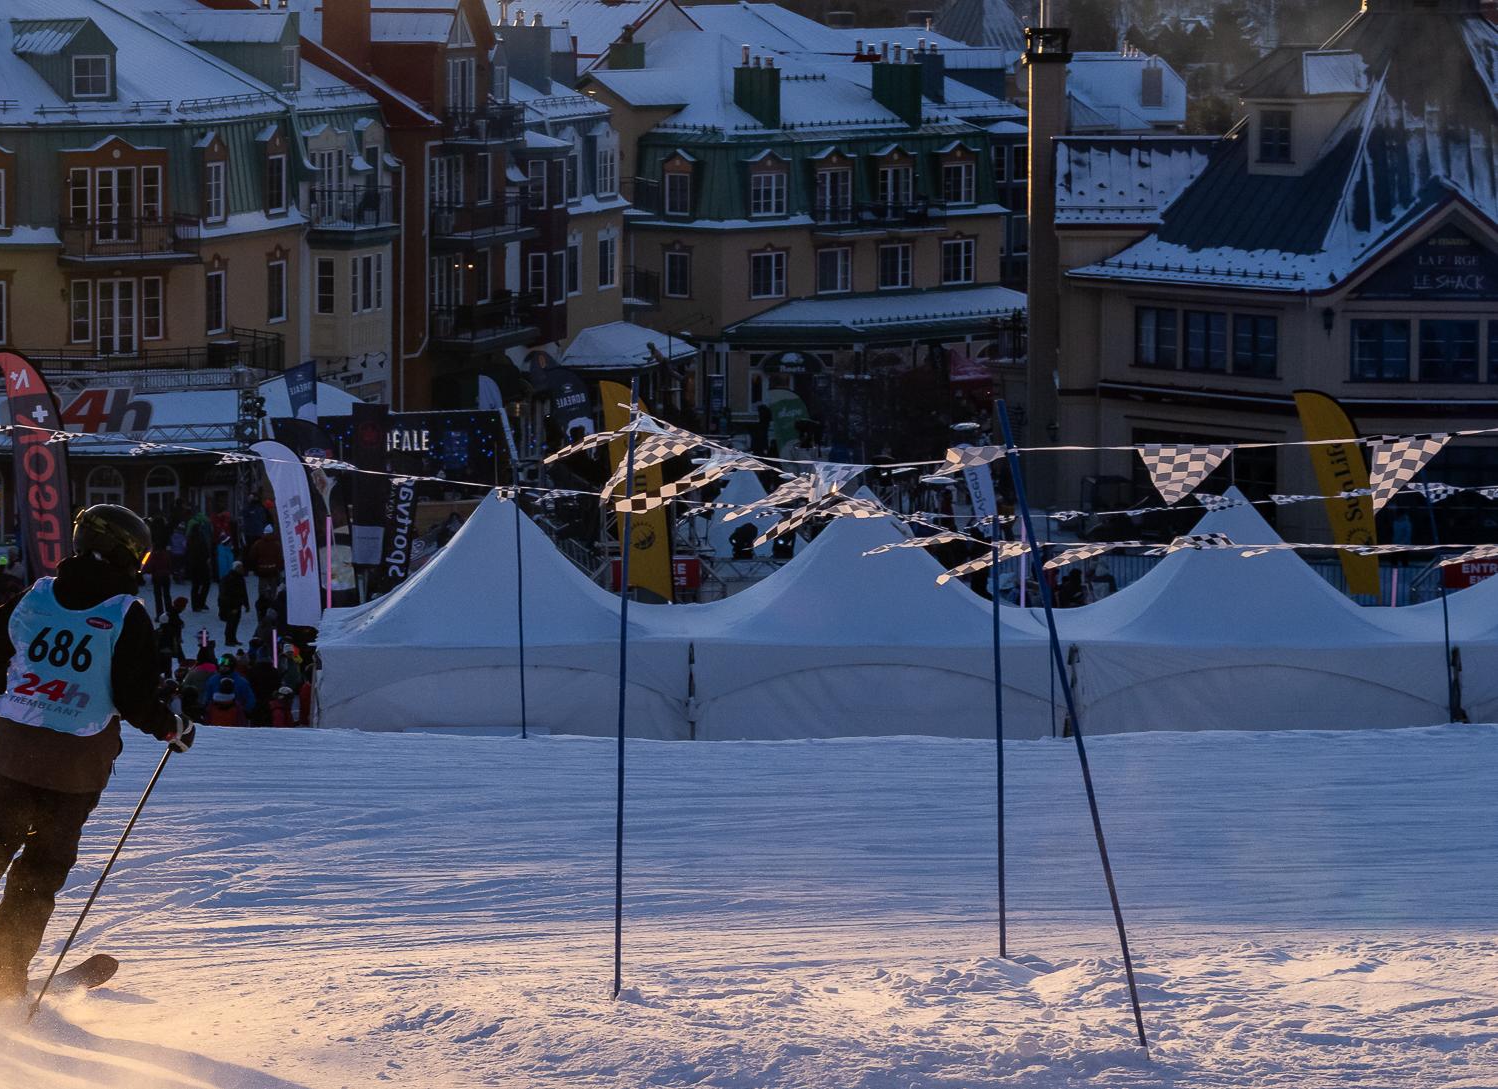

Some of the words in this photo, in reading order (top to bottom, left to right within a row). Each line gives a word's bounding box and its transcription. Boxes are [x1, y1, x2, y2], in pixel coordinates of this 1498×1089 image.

[1437, 255, 1479, 266] FRGE
[1413, 274, 1431, 287] LE
[1435, 273, 1485, 290] SHACK
[57, 388, 152, 434] 4h
[28, 627, 93, 672] 686
[14, 672, 91, 709] 24h
[9, 695, 82, 719] TREMBLANT
